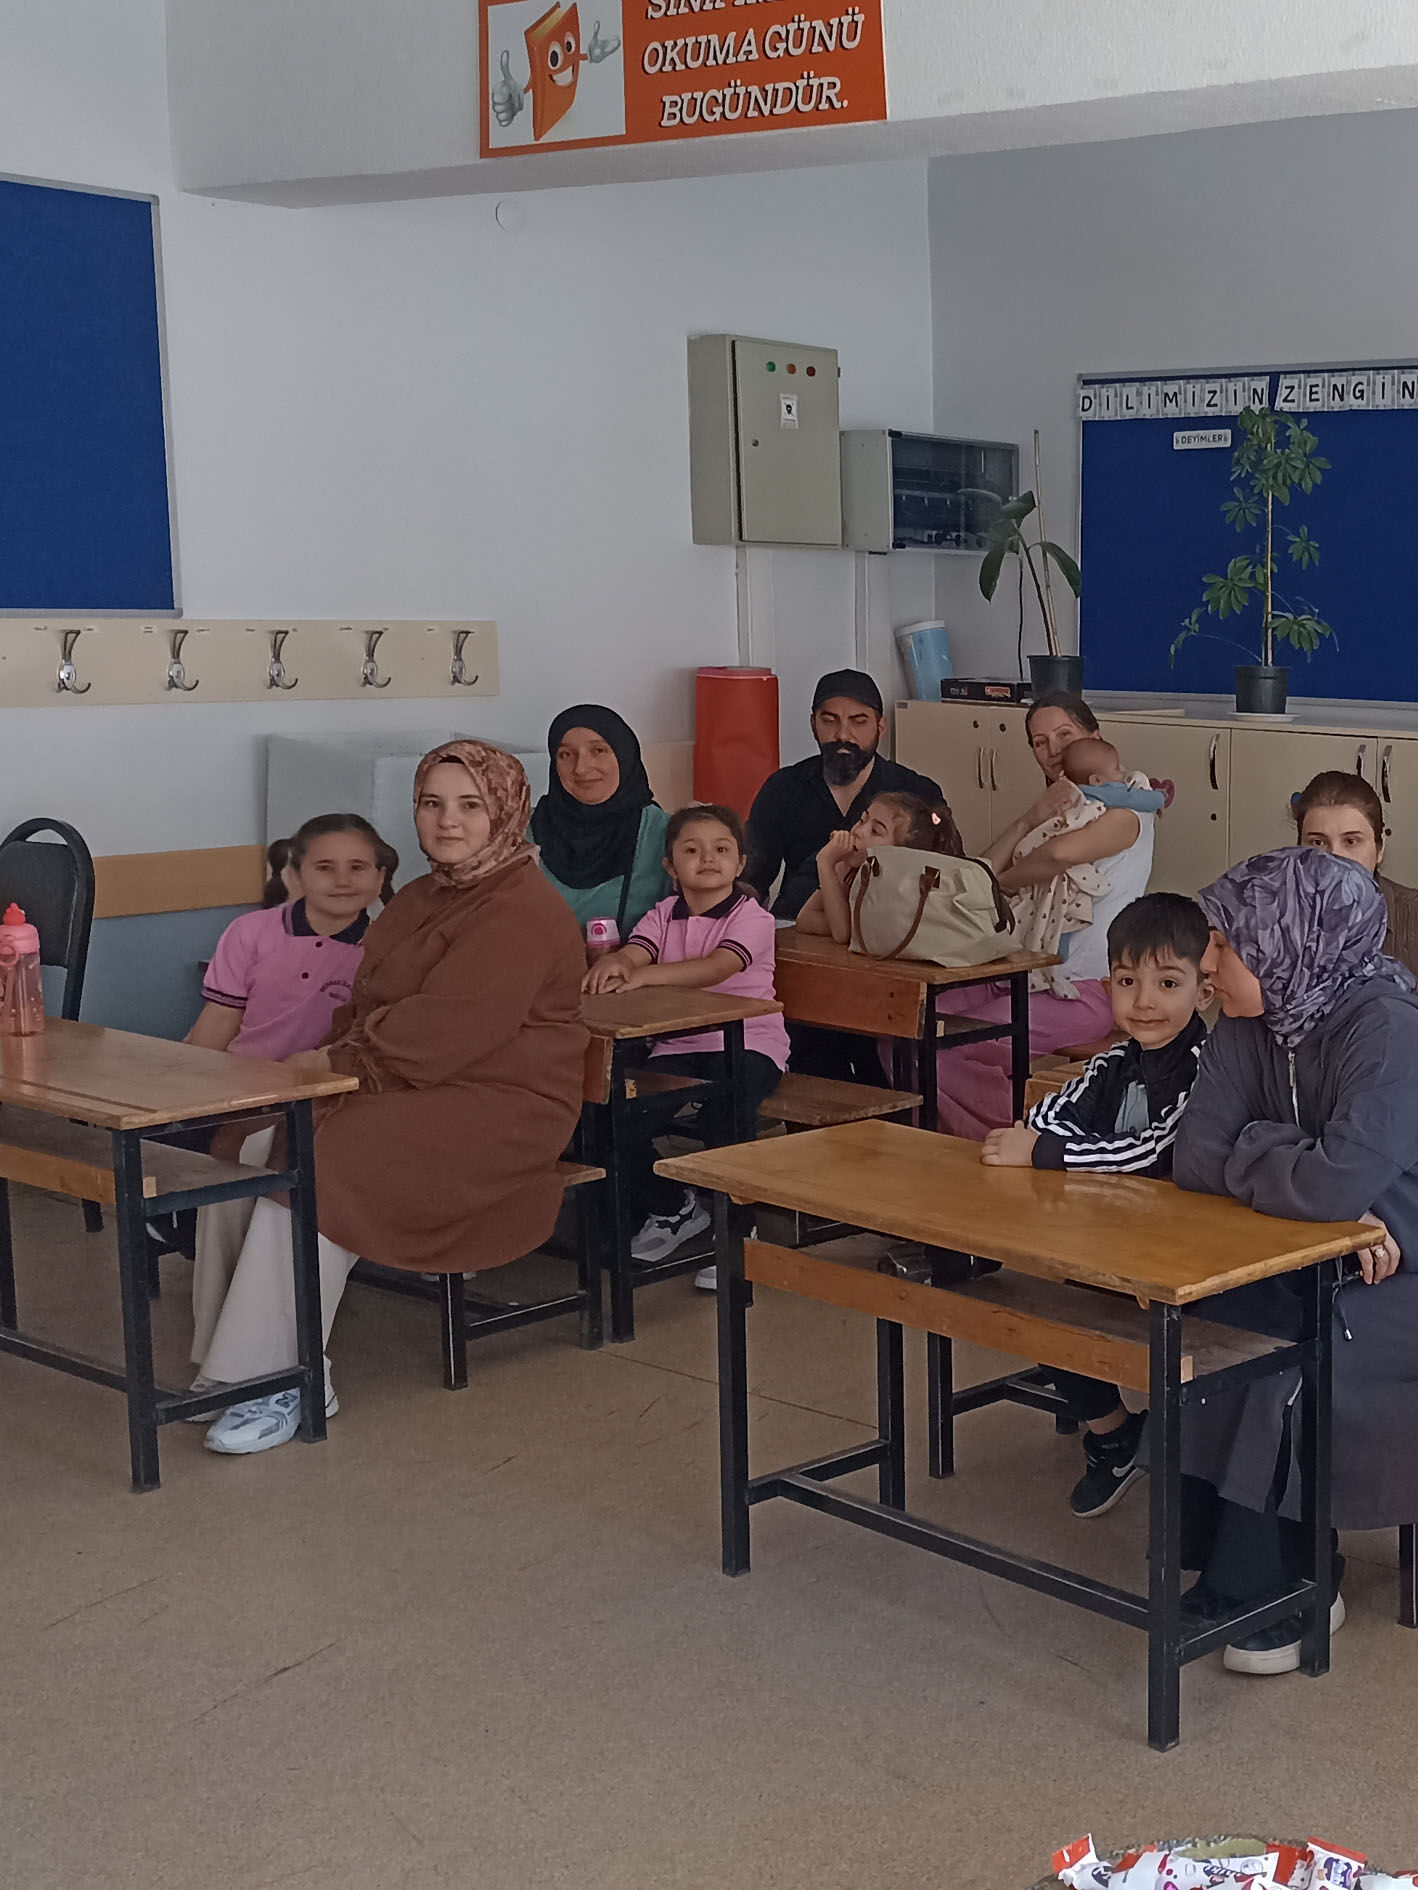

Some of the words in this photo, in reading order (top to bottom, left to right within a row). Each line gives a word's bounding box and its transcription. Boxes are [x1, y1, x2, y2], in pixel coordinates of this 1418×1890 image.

[643, 28, 760, 74] OKUMA
[764, 7, 865, 58] GÜNÜ
[659, 71, 849, 128] BUGÜNDÜR.
[1080, 384, 1265, 412] DİLİMİZİN
[1181, 433, 1223, 445] DEYİMLER
